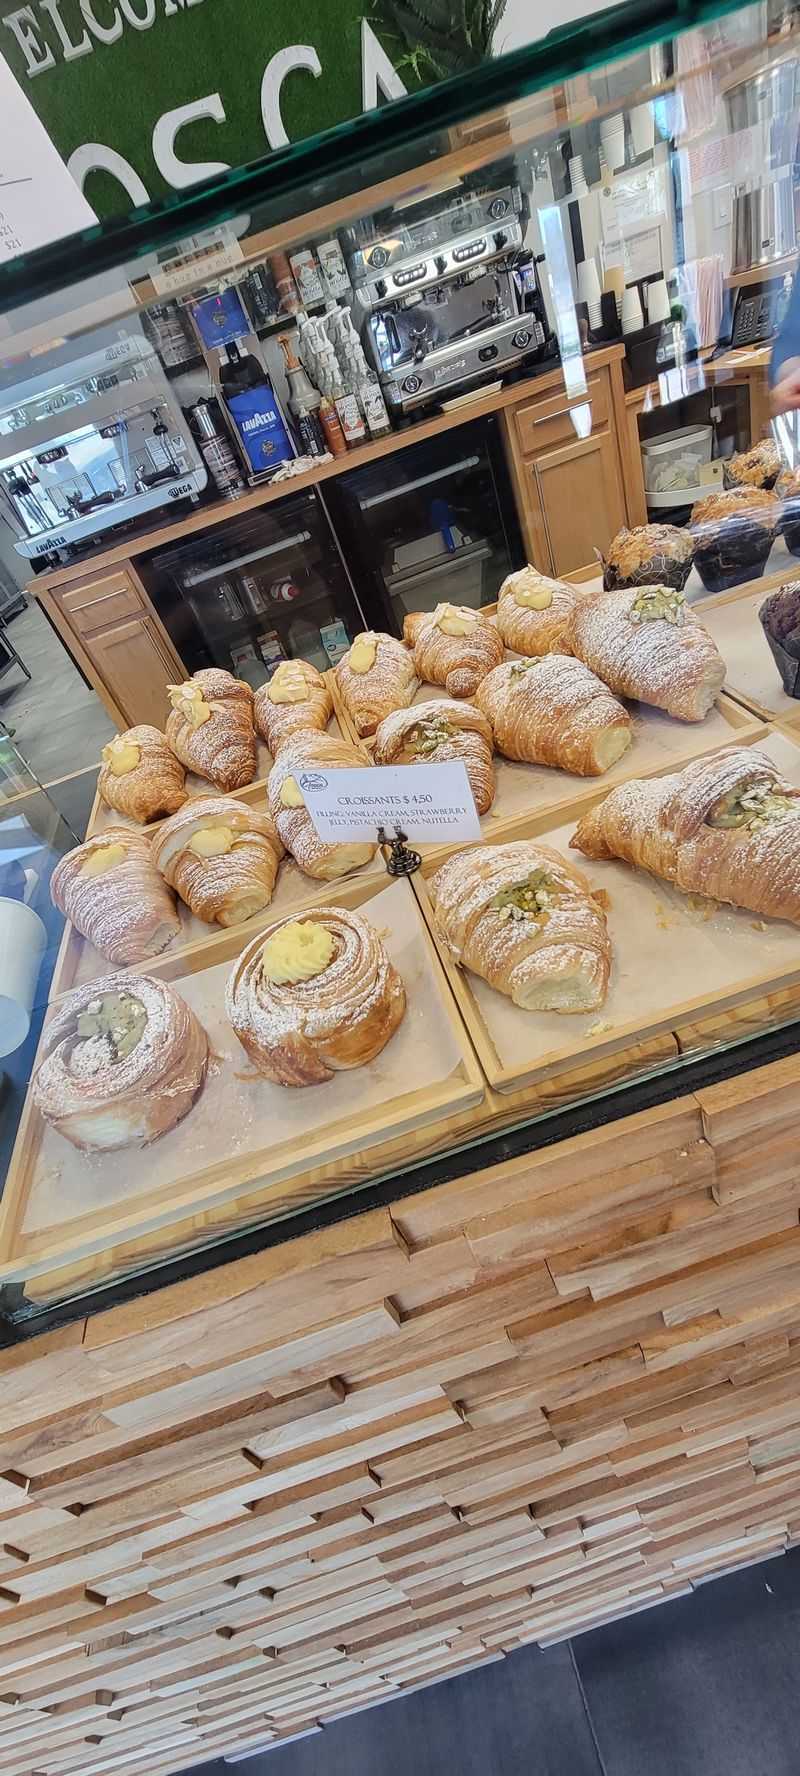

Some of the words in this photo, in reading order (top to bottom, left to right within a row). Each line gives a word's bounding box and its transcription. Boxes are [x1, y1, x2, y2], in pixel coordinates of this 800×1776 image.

[241, 410, 277, 433] LAVAZZA
[35, 535, 68, 554] LAVAZZA
[336, 796, 401, 806] CROISSANTS
[402, 795, 411, 804] $
[421, 816, 460, 824] NUTELLA
